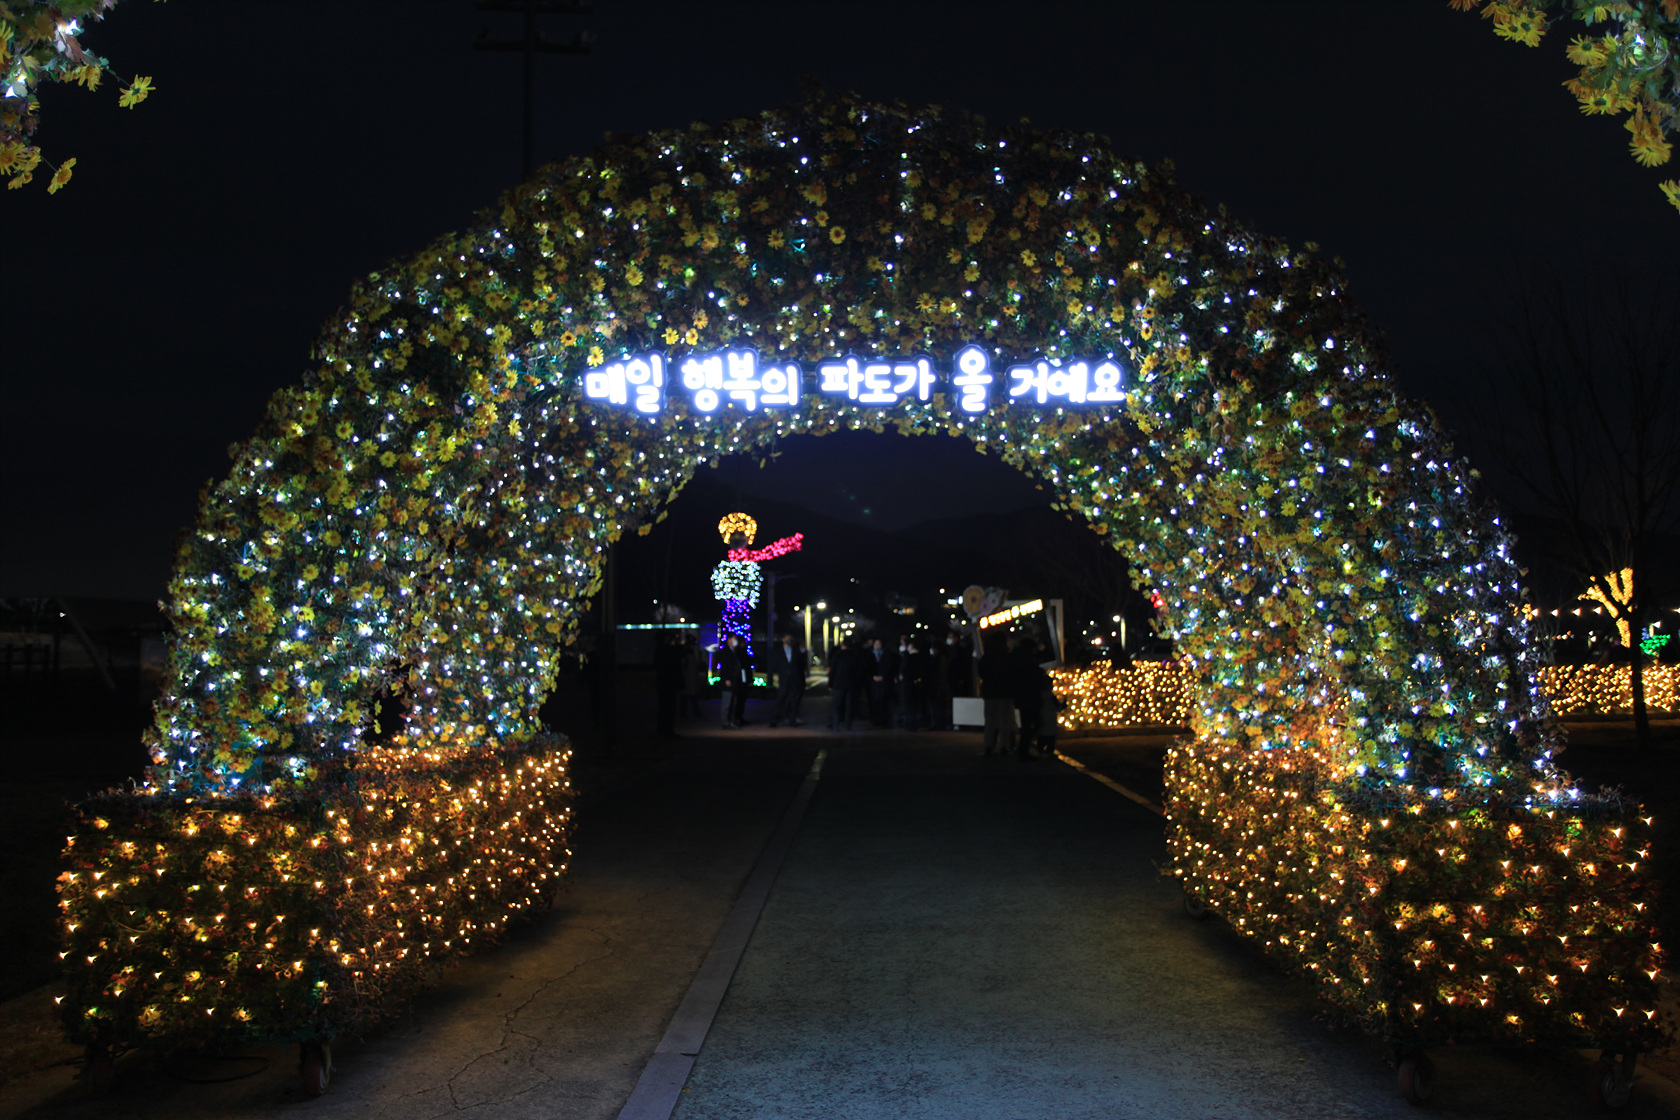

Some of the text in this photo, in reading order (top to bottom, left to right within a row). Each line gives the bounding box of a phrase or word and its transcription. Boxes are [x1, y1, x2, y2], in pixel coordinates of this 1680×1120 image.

[585, 347, 1126, 413] 매일 행복의 파도가 올 거예요
